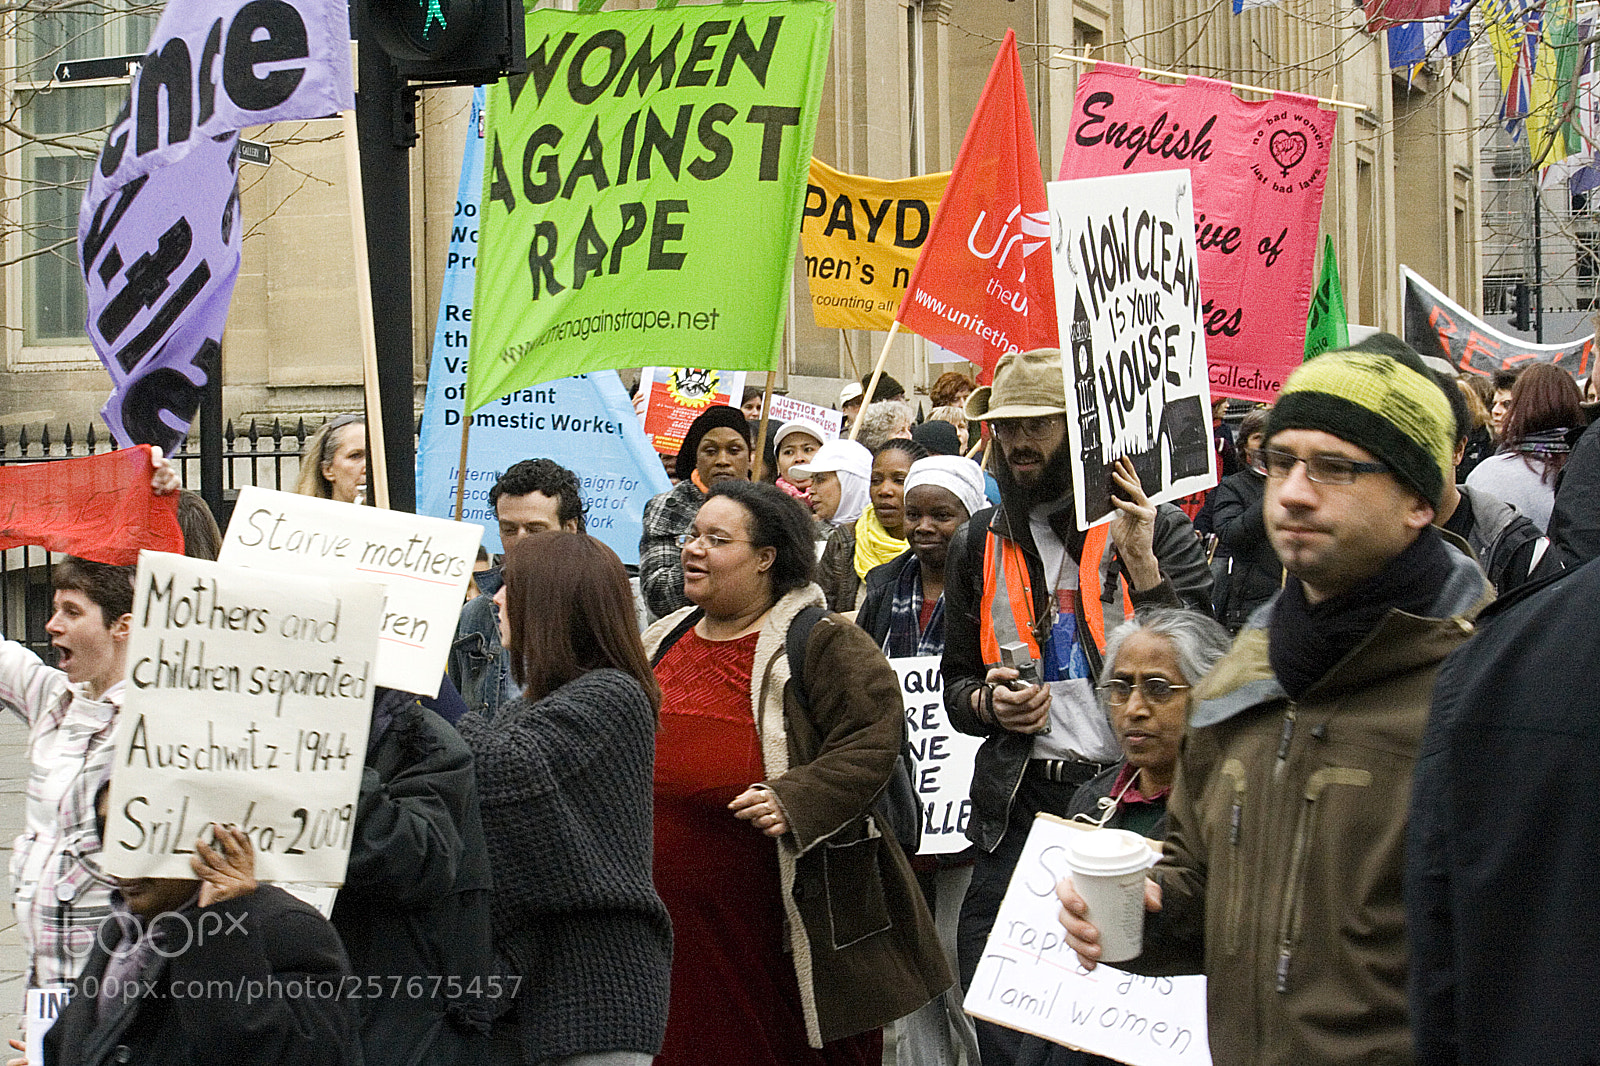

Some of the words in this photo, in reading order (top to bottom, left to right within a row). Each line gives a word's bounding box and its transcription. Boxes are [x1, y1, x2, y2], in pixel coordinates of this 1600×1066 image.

[507, 15, 785, 114] WOMEN
[490, 103, 801, 214] AGAINST
[1075, 91, 1218, 169] English
[1252, 130, 1264, 145] no
[1266, 111, 1287, 126] bad
[1294, 114, 1324, 149] women
[1272, 182, 1293, 193] bad
[1299, 168, 1321, 190] laws
[528, 199, 690, 301] RAPE
[1079, 206, 1132, 321] HOW
[1134, 209, 1200, 326] CLEAN
[1258, 228, 1288, 267] of
[816, 295, 874, 312] counting
[878, 300, 894, 312] all
[1109, 297, 1126, 343] IS
[1127, 287, 1165, 328] YOUR
[776, 398, 816, 416] JUSTICE
[1208, 363, 1281, 392] Collective
[619, 476, 639, 491] for
[239, 508, 351, 558] Starve
[359, 533, 467, 578] mothers
[143, 572, 270, 635] Mothers
[280, 597, 342, 644] and
[132, 638, 240, 691] children
[249, 655, 370, 718] separated
[987, 953, 1063, 1020] Tamil
[1072, 998, 1193, 1056] women
